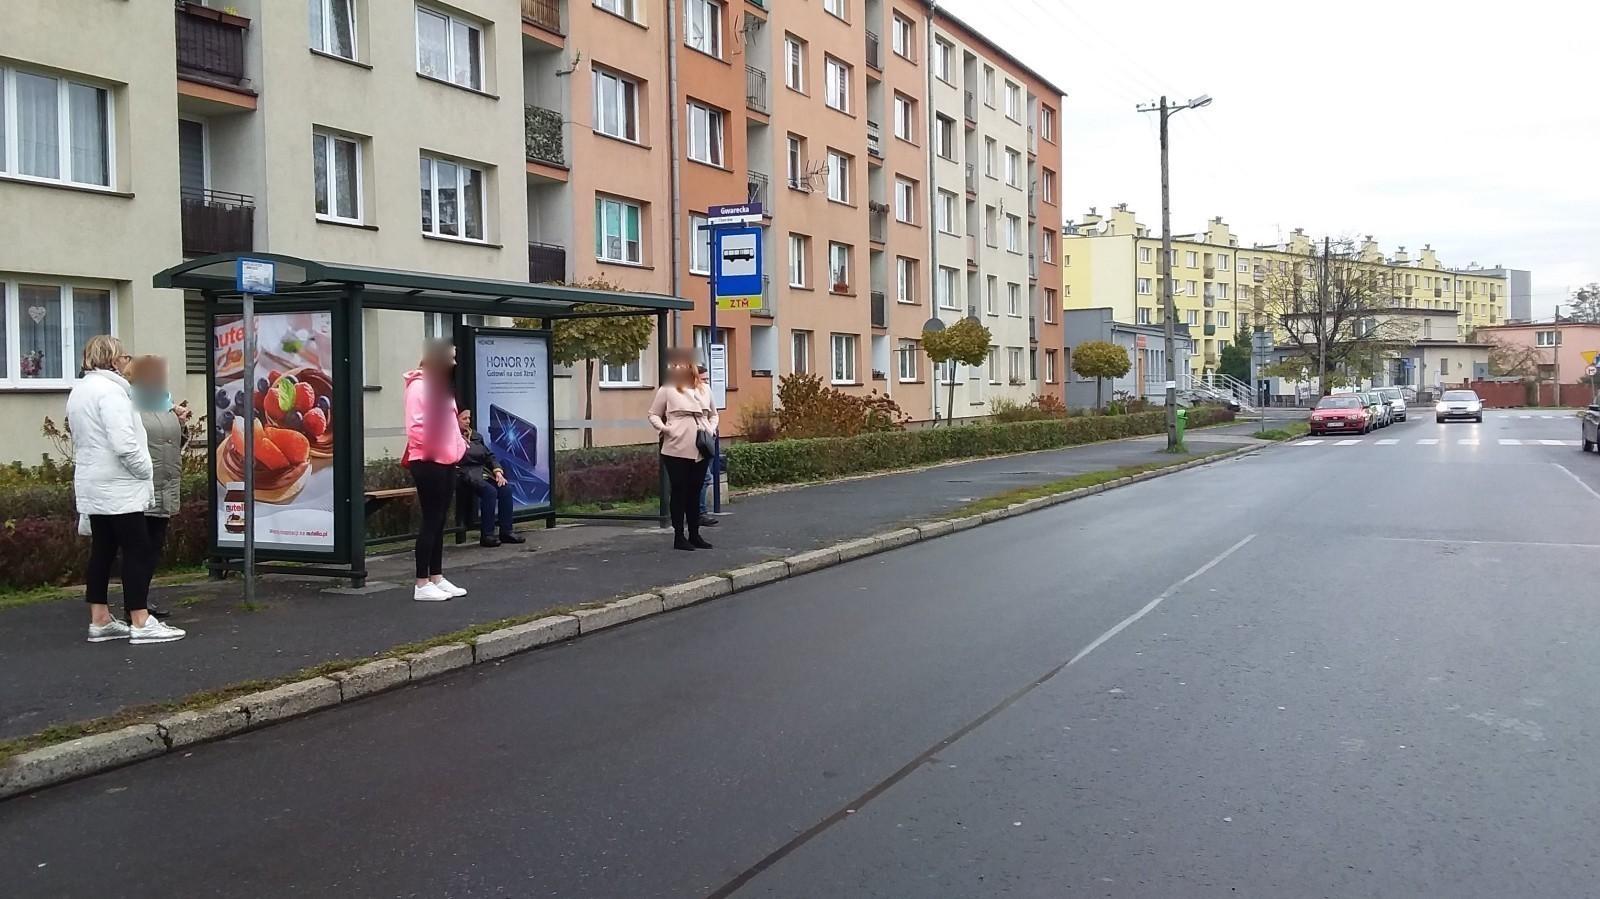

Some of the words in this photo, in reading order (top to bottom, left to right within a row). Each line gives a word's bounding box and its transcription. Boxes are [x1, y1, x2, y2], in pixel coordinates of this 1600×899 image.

[720, 206, 749, 214] Gwarecka
[730, 298, 748, 308] ZTM
[487, 356, 521, 368] HONOR
[523, 356, 536, 368] 9X
